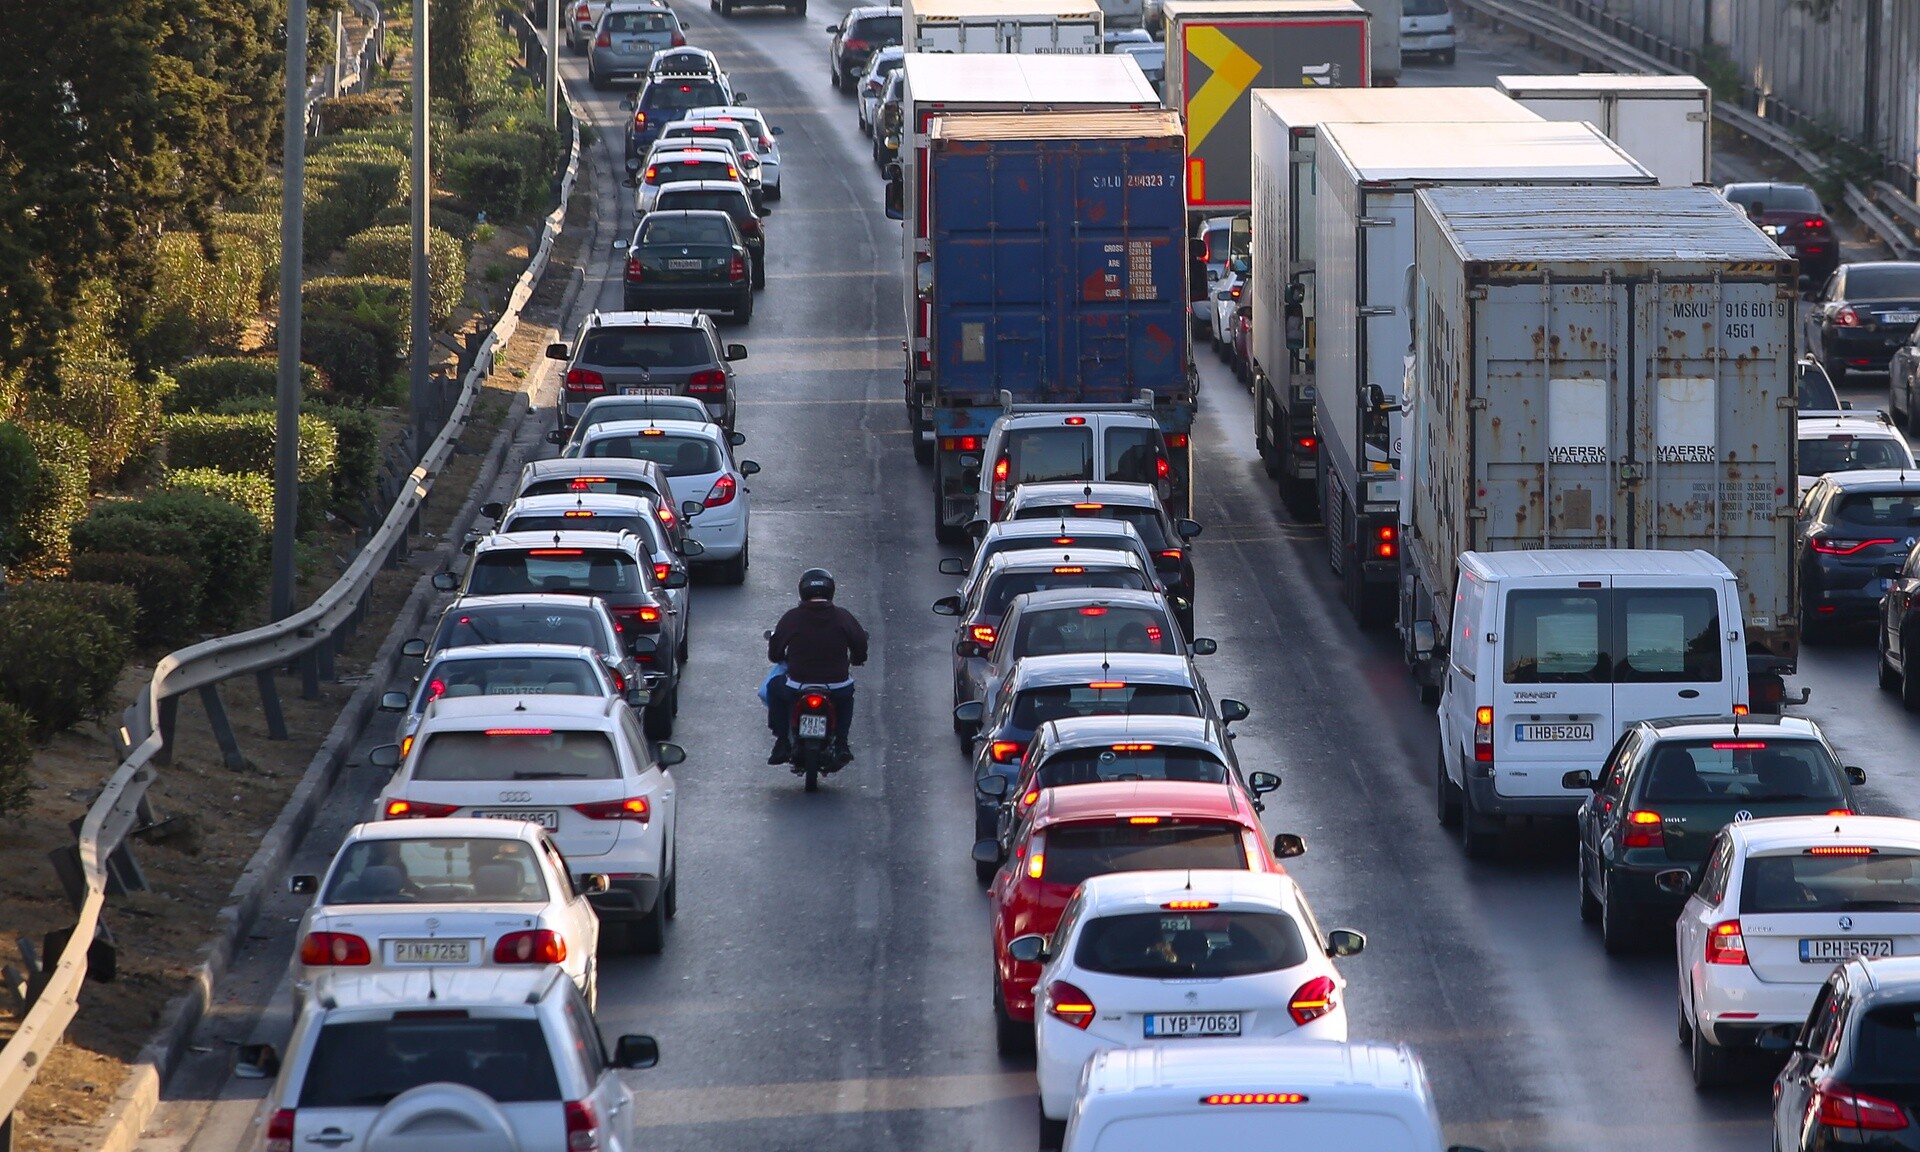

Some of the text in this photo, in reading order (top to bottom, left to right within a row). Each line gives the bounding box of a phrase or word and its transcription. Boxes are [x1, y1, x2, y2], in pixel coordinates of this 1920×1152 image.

[1104, 244, 1123, 252] GROSS
[1105, 274, 1116, 282] NET
[1105, 288, 1121, 297] CUBE
[1673, 303, 1708, 318] MSKU
[1725, 323, 1754, 338] 45G1
[1549, 446, 1606, 456] MAERSK
[1656, 445, 1715, 455] MAERSK
